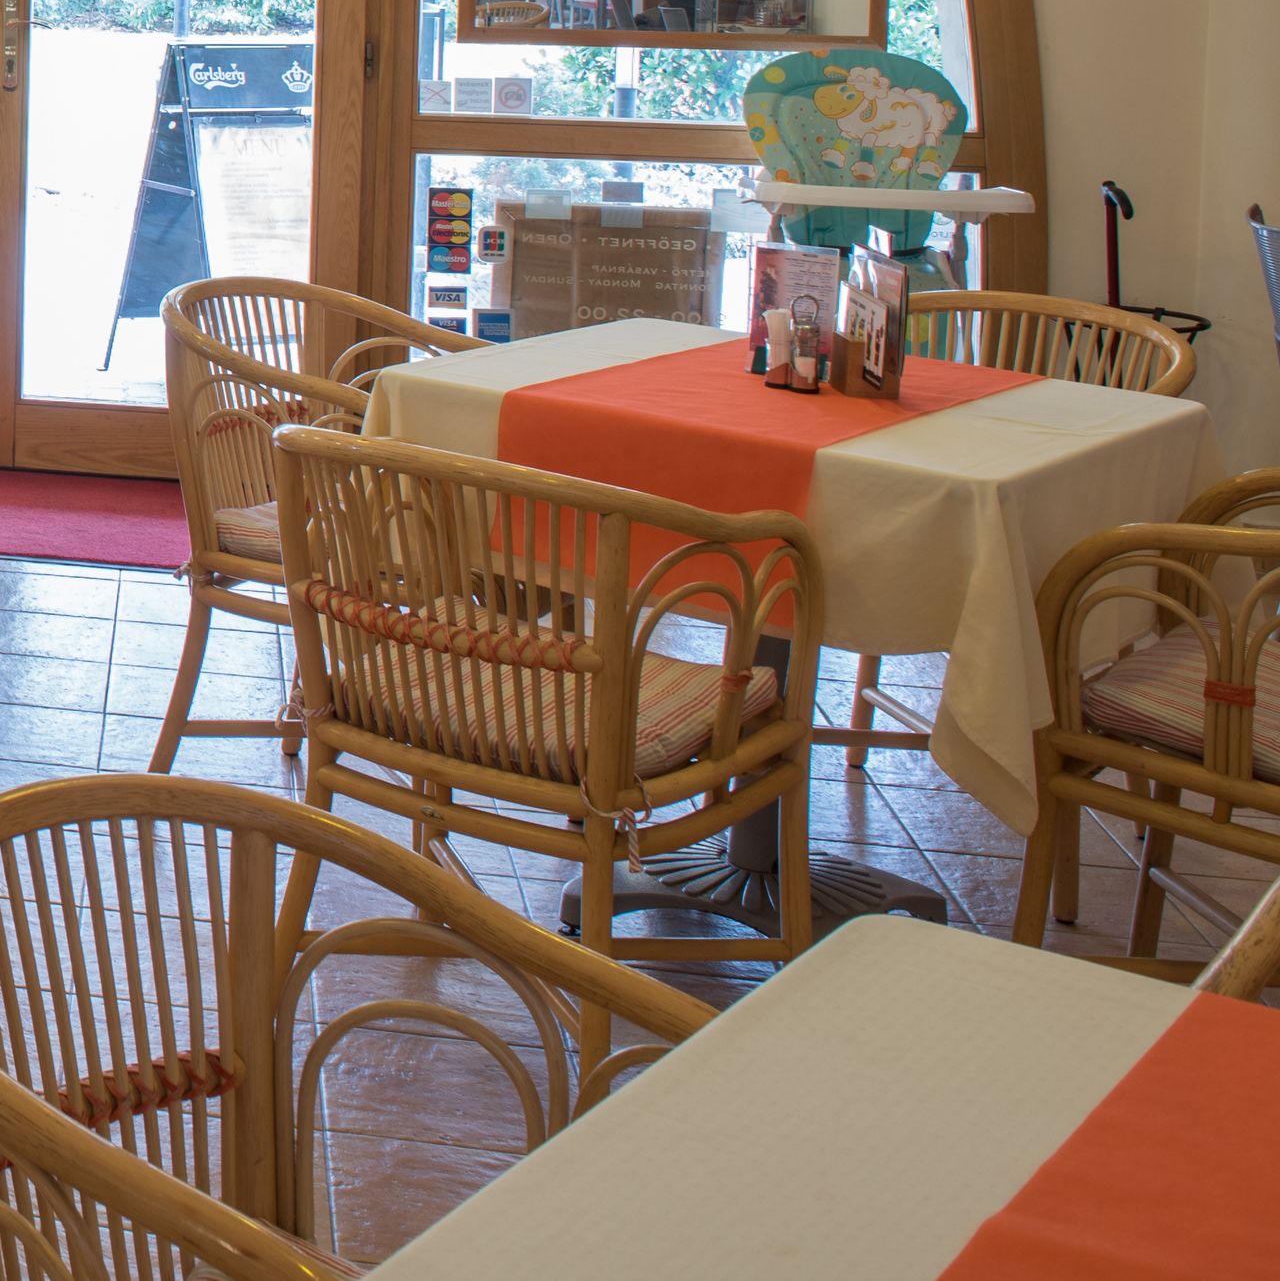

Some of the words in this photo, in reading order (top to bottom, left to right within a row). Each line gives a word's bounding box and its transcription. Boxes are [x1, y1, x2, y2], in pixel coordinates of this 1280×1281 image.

[189, 63, 246, 90] Carlsberg
[433, 254, 467, 263] Maestro
[434, 293, 461, 302] VISA
